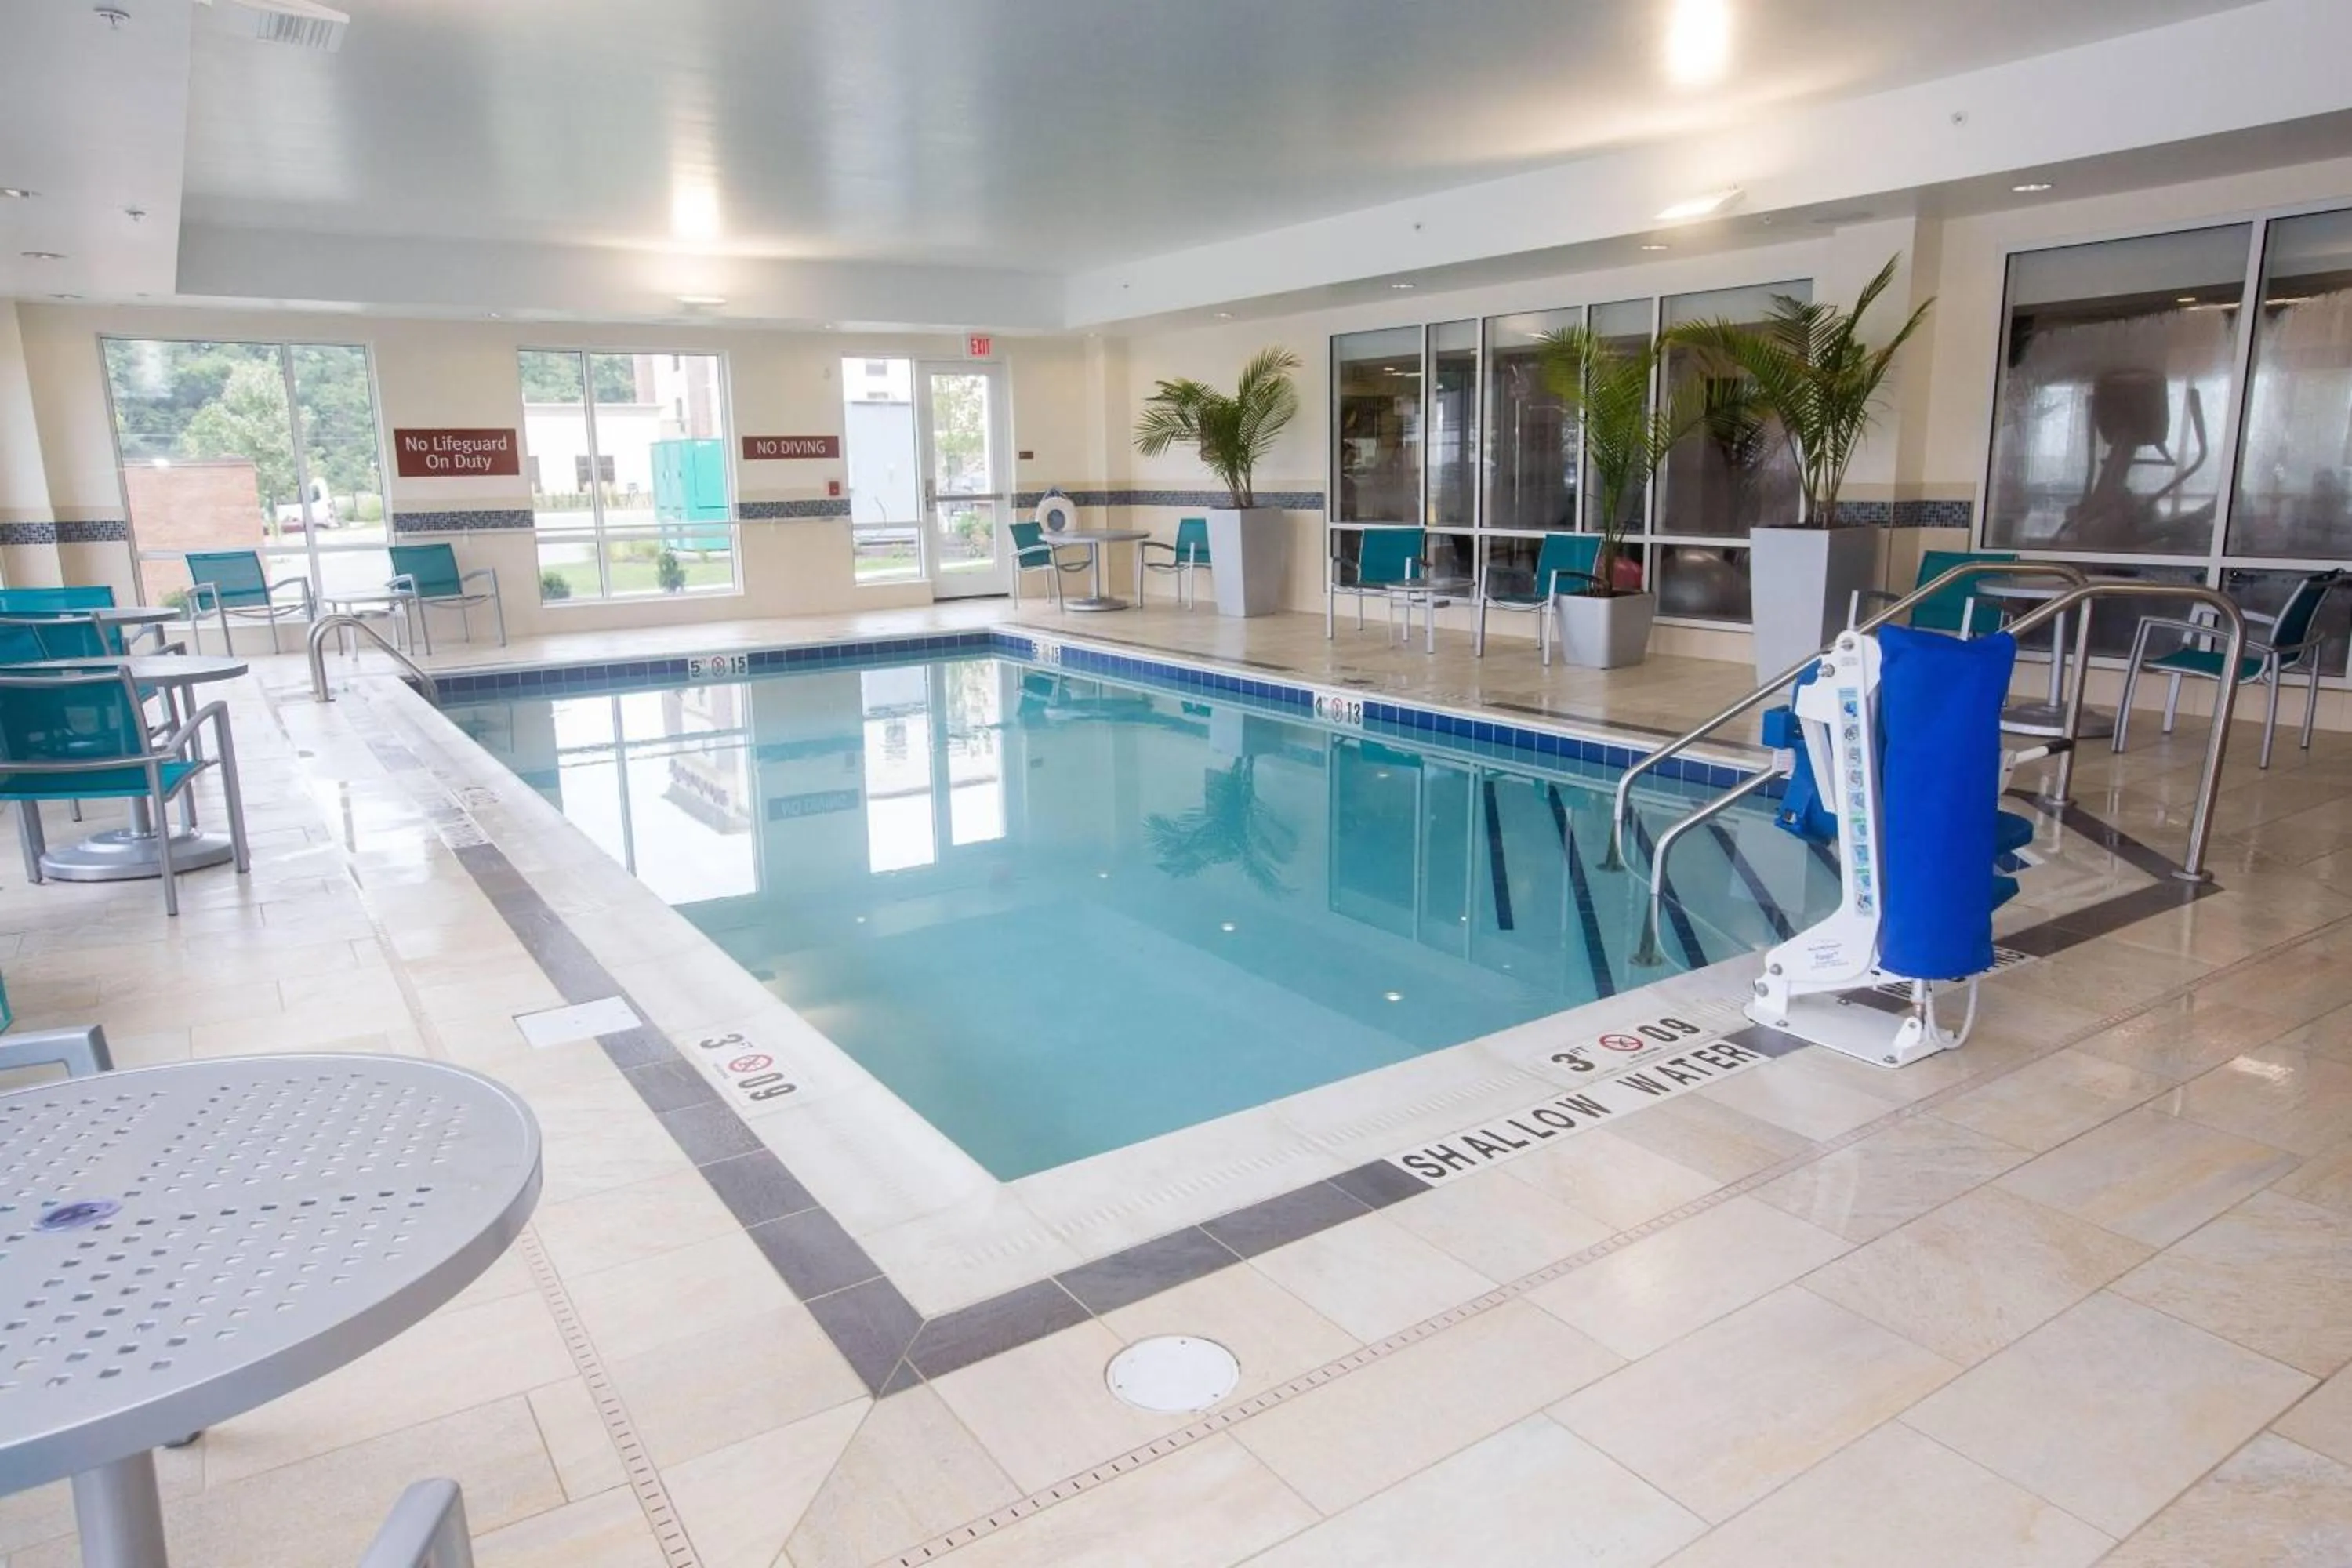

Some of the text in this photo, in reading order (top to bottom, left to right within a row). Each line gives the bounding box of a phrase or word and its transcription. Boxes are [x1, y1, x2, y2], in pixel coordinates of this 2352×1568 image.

[971, 338, 990, 355] EXIT
[405, 436, 508, 453] No Lifeguard
[757, 440, 826, 455] NO DIVING
[426, 454, 492, 470] On Duty
[700, 1033, 744, 1049] 3
[1551, 1053, 1595, 1072] 3
[1402, 1044, 1758, 1179] SHALLOW WATER
